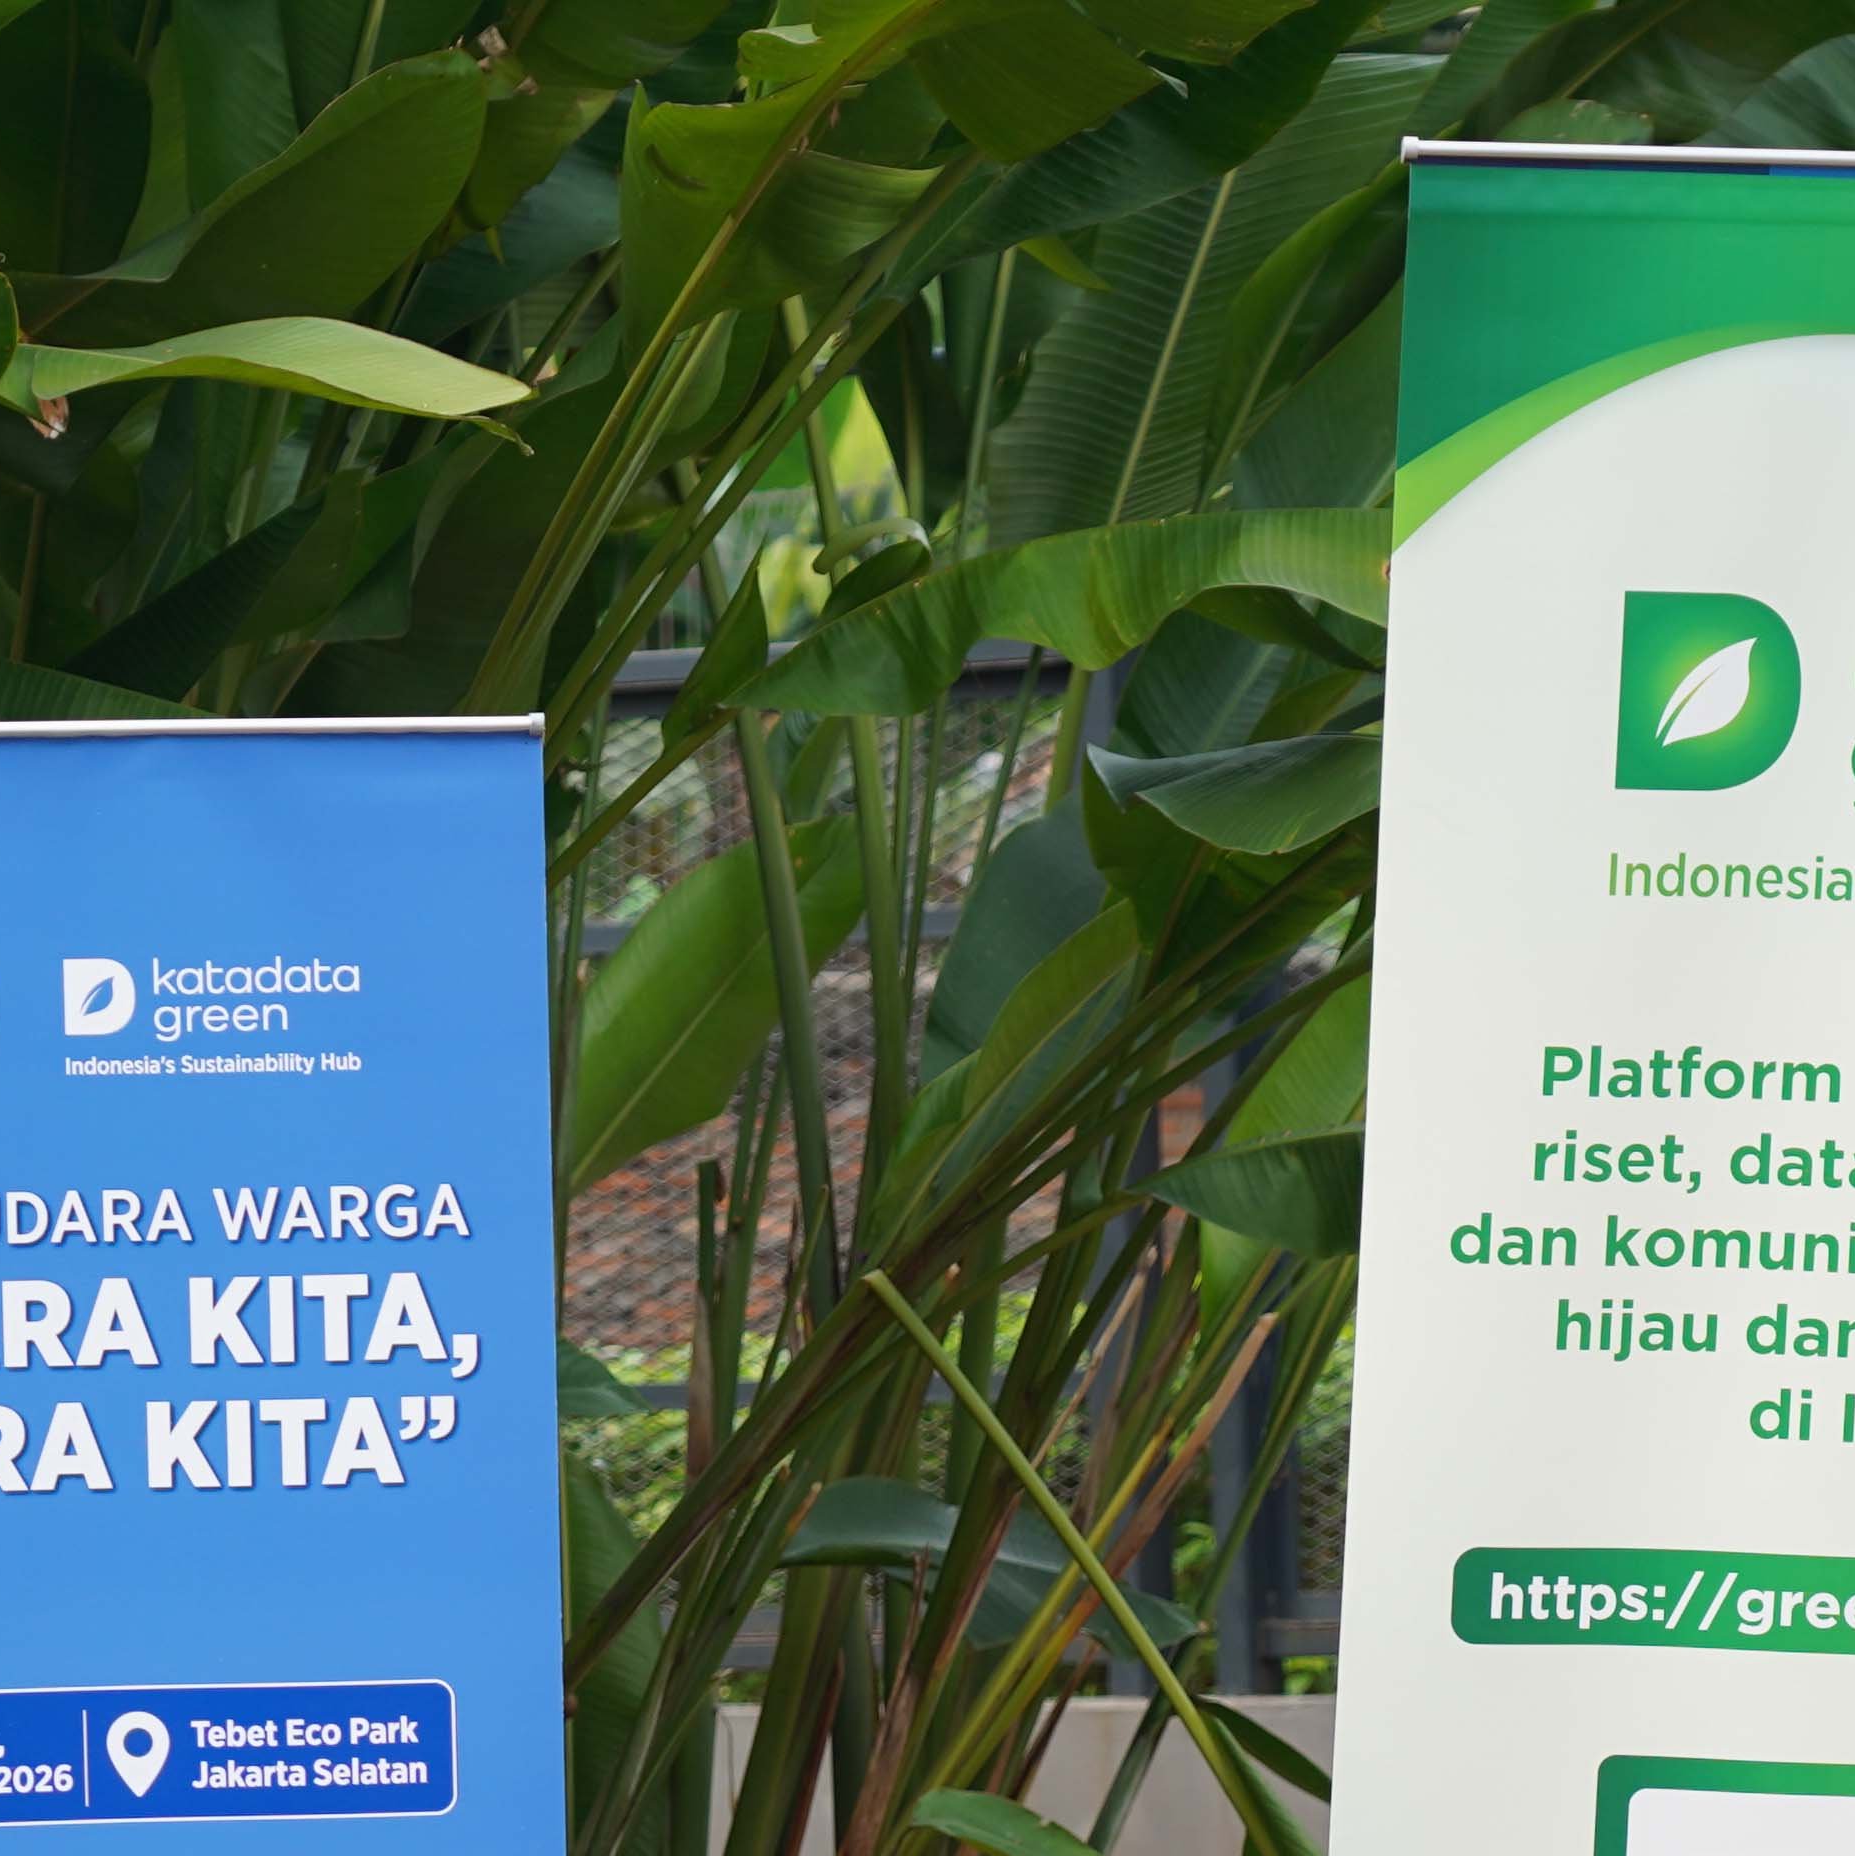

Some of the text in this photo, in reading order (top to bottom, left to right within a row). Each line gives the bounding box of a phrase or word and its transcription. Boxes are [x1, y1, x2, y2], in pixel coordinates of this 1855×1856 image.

[152, 955, 361, 996] katadata
[153, 1003, 289, 1043] green
[65, 1051, 362, 1076] Indonesia's Sustainability Hub
[1542, 1046, 1842, 1104] Platform
[1534, 1130, 1701, 1192] riset,
[212, 1183, 470, 1241] WARGA
[1450, 1212, 1577, 1265] dan
[188, 1271, 478, 1378] KITA,
[1556, 1299, 1719, 1361] hijau
[1750, 1388, 1813, 1441] di
[145, 1395, 456, 1489] KITA”
[190, 1715, 419, 1748] Tebet Eco Park
[192, 1757, 428, 1789] Jakarta Selatan
